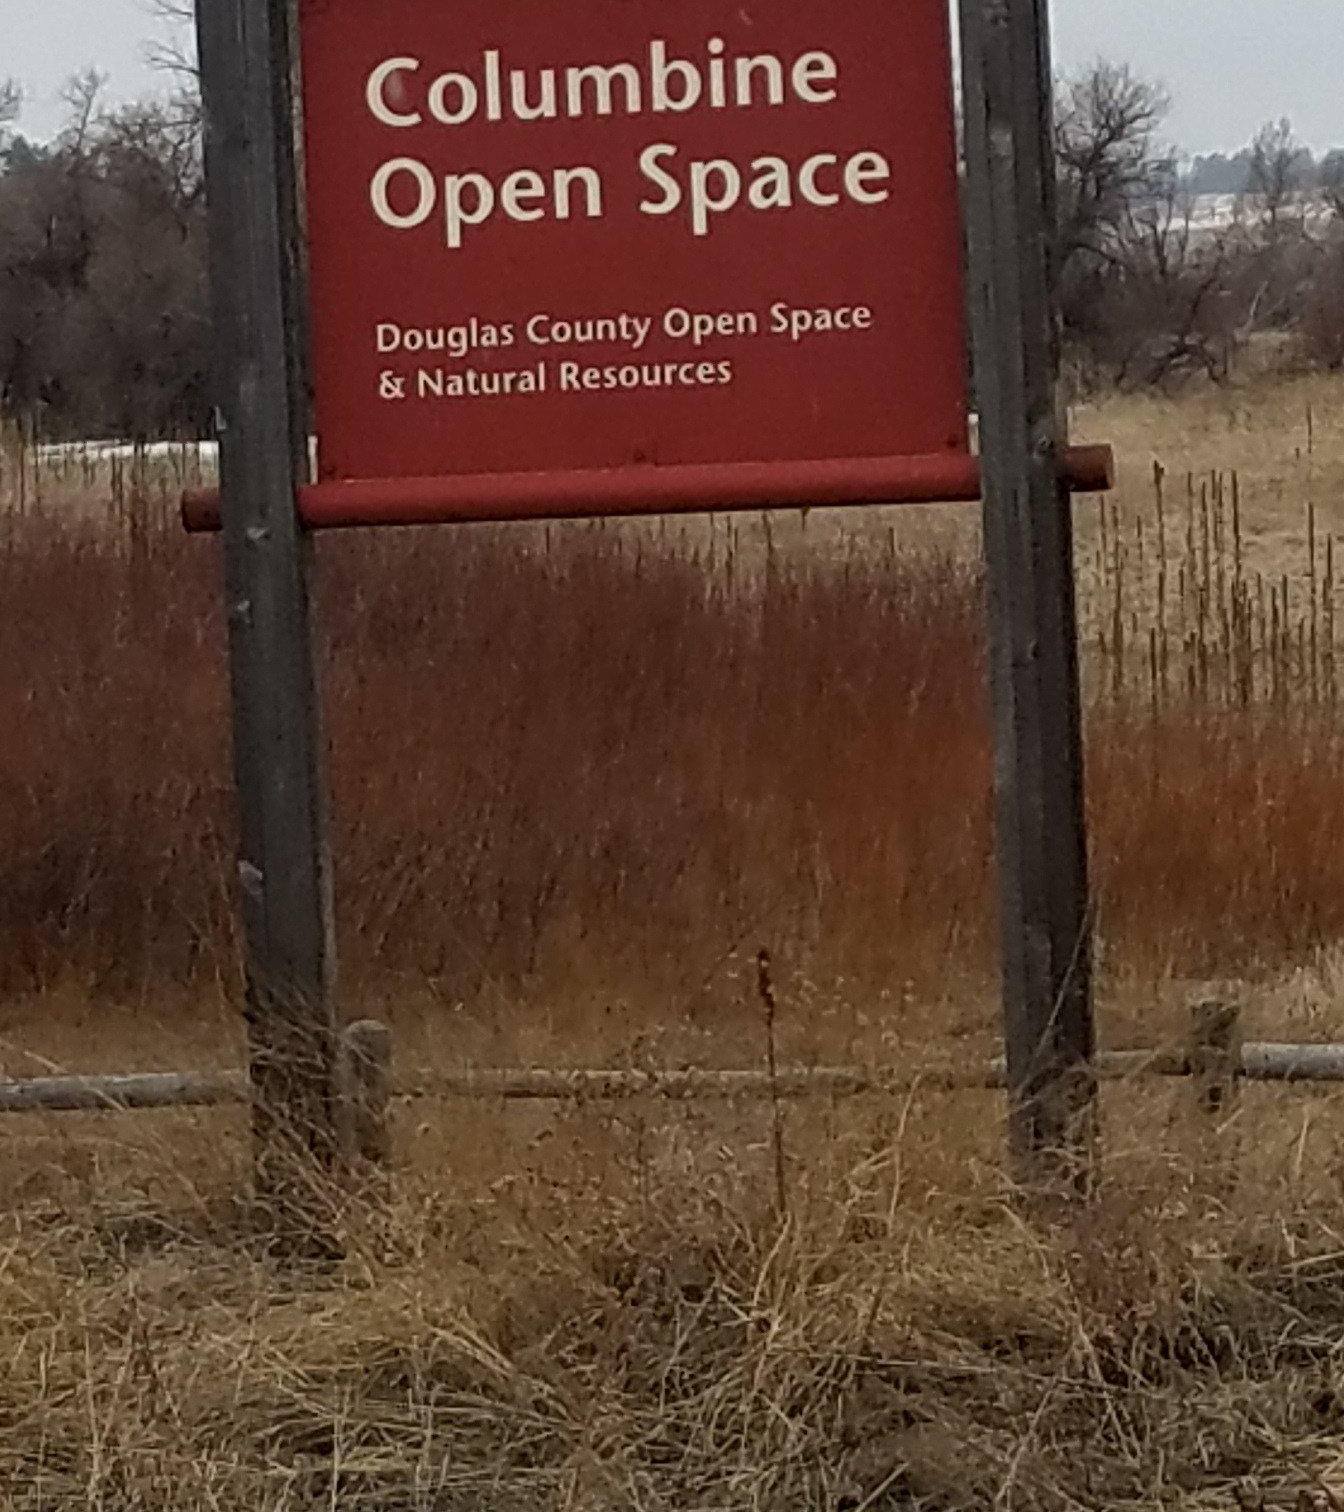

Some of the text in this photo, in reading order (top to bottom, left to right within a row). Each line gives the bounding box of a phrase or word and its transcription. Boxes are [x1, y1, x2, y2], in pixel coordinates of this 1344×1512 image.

[365, 37, 838, 127] Columbine
[369, 143, 891, 248] Open Space
[375, 301, 873, 358] Douglas County Open Space
[378, 358, 733, 400] & Natural Resources
